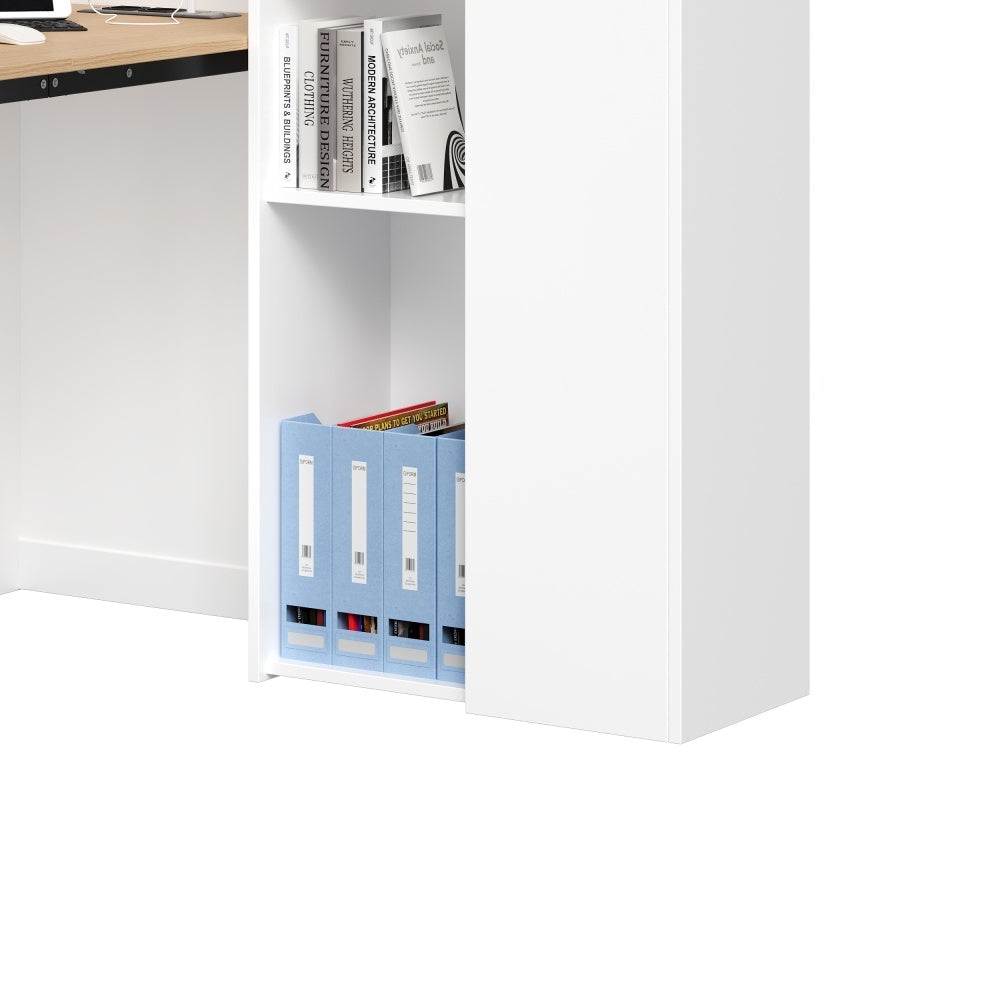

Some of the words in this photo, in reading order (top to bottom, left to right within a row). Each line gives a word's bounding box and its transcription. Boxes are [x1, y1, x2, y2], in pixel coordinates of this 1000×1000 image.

[304, 71, 314, 126] CLOTHING
[320, 32, 330, 125] FURNITURE
[368, 55, 376, 93] MODERN
[342, 78, 354, 132] WUTHERING
[368, 96, 376, 165] ARCHITECTURE
[320, 130, 330, 189] DESIGN
[342, 135, 354, 173] HEIGHTS
[375, 421, 392, 431] PLANS
[393, 419, 400, 427] TO
[401, 416, 411, 425] GET
[413, 413, 423, 422] YOU
[424, 407, 447, 419] STARTED
